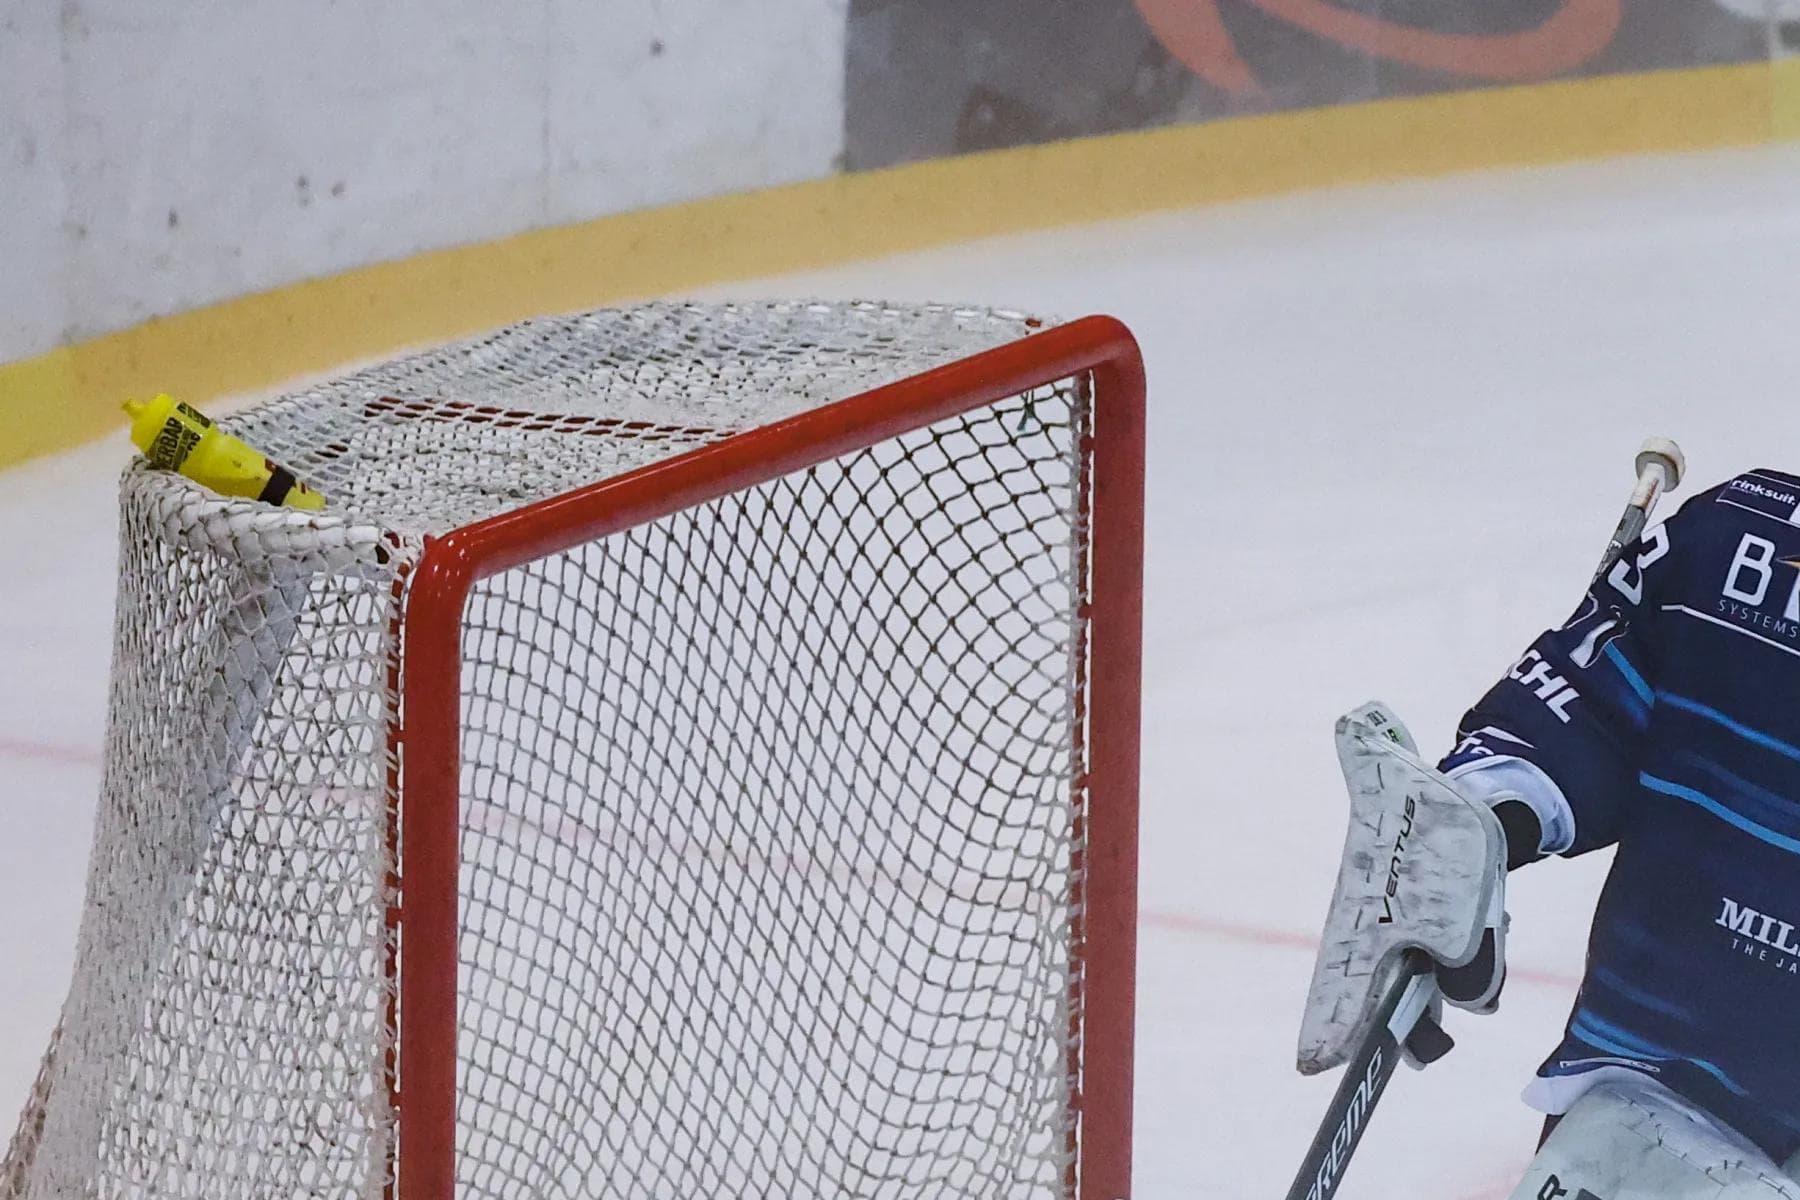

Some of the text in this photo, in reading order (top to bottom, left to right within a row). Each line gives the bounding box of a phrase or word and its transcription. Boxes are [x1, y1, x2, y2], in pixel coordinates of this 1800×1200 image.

[1718, 598, 1800, 639] SYSTEMS
[1506, 648, 1581, 725] CHL
[1731, 937, 1768, 962] THE
